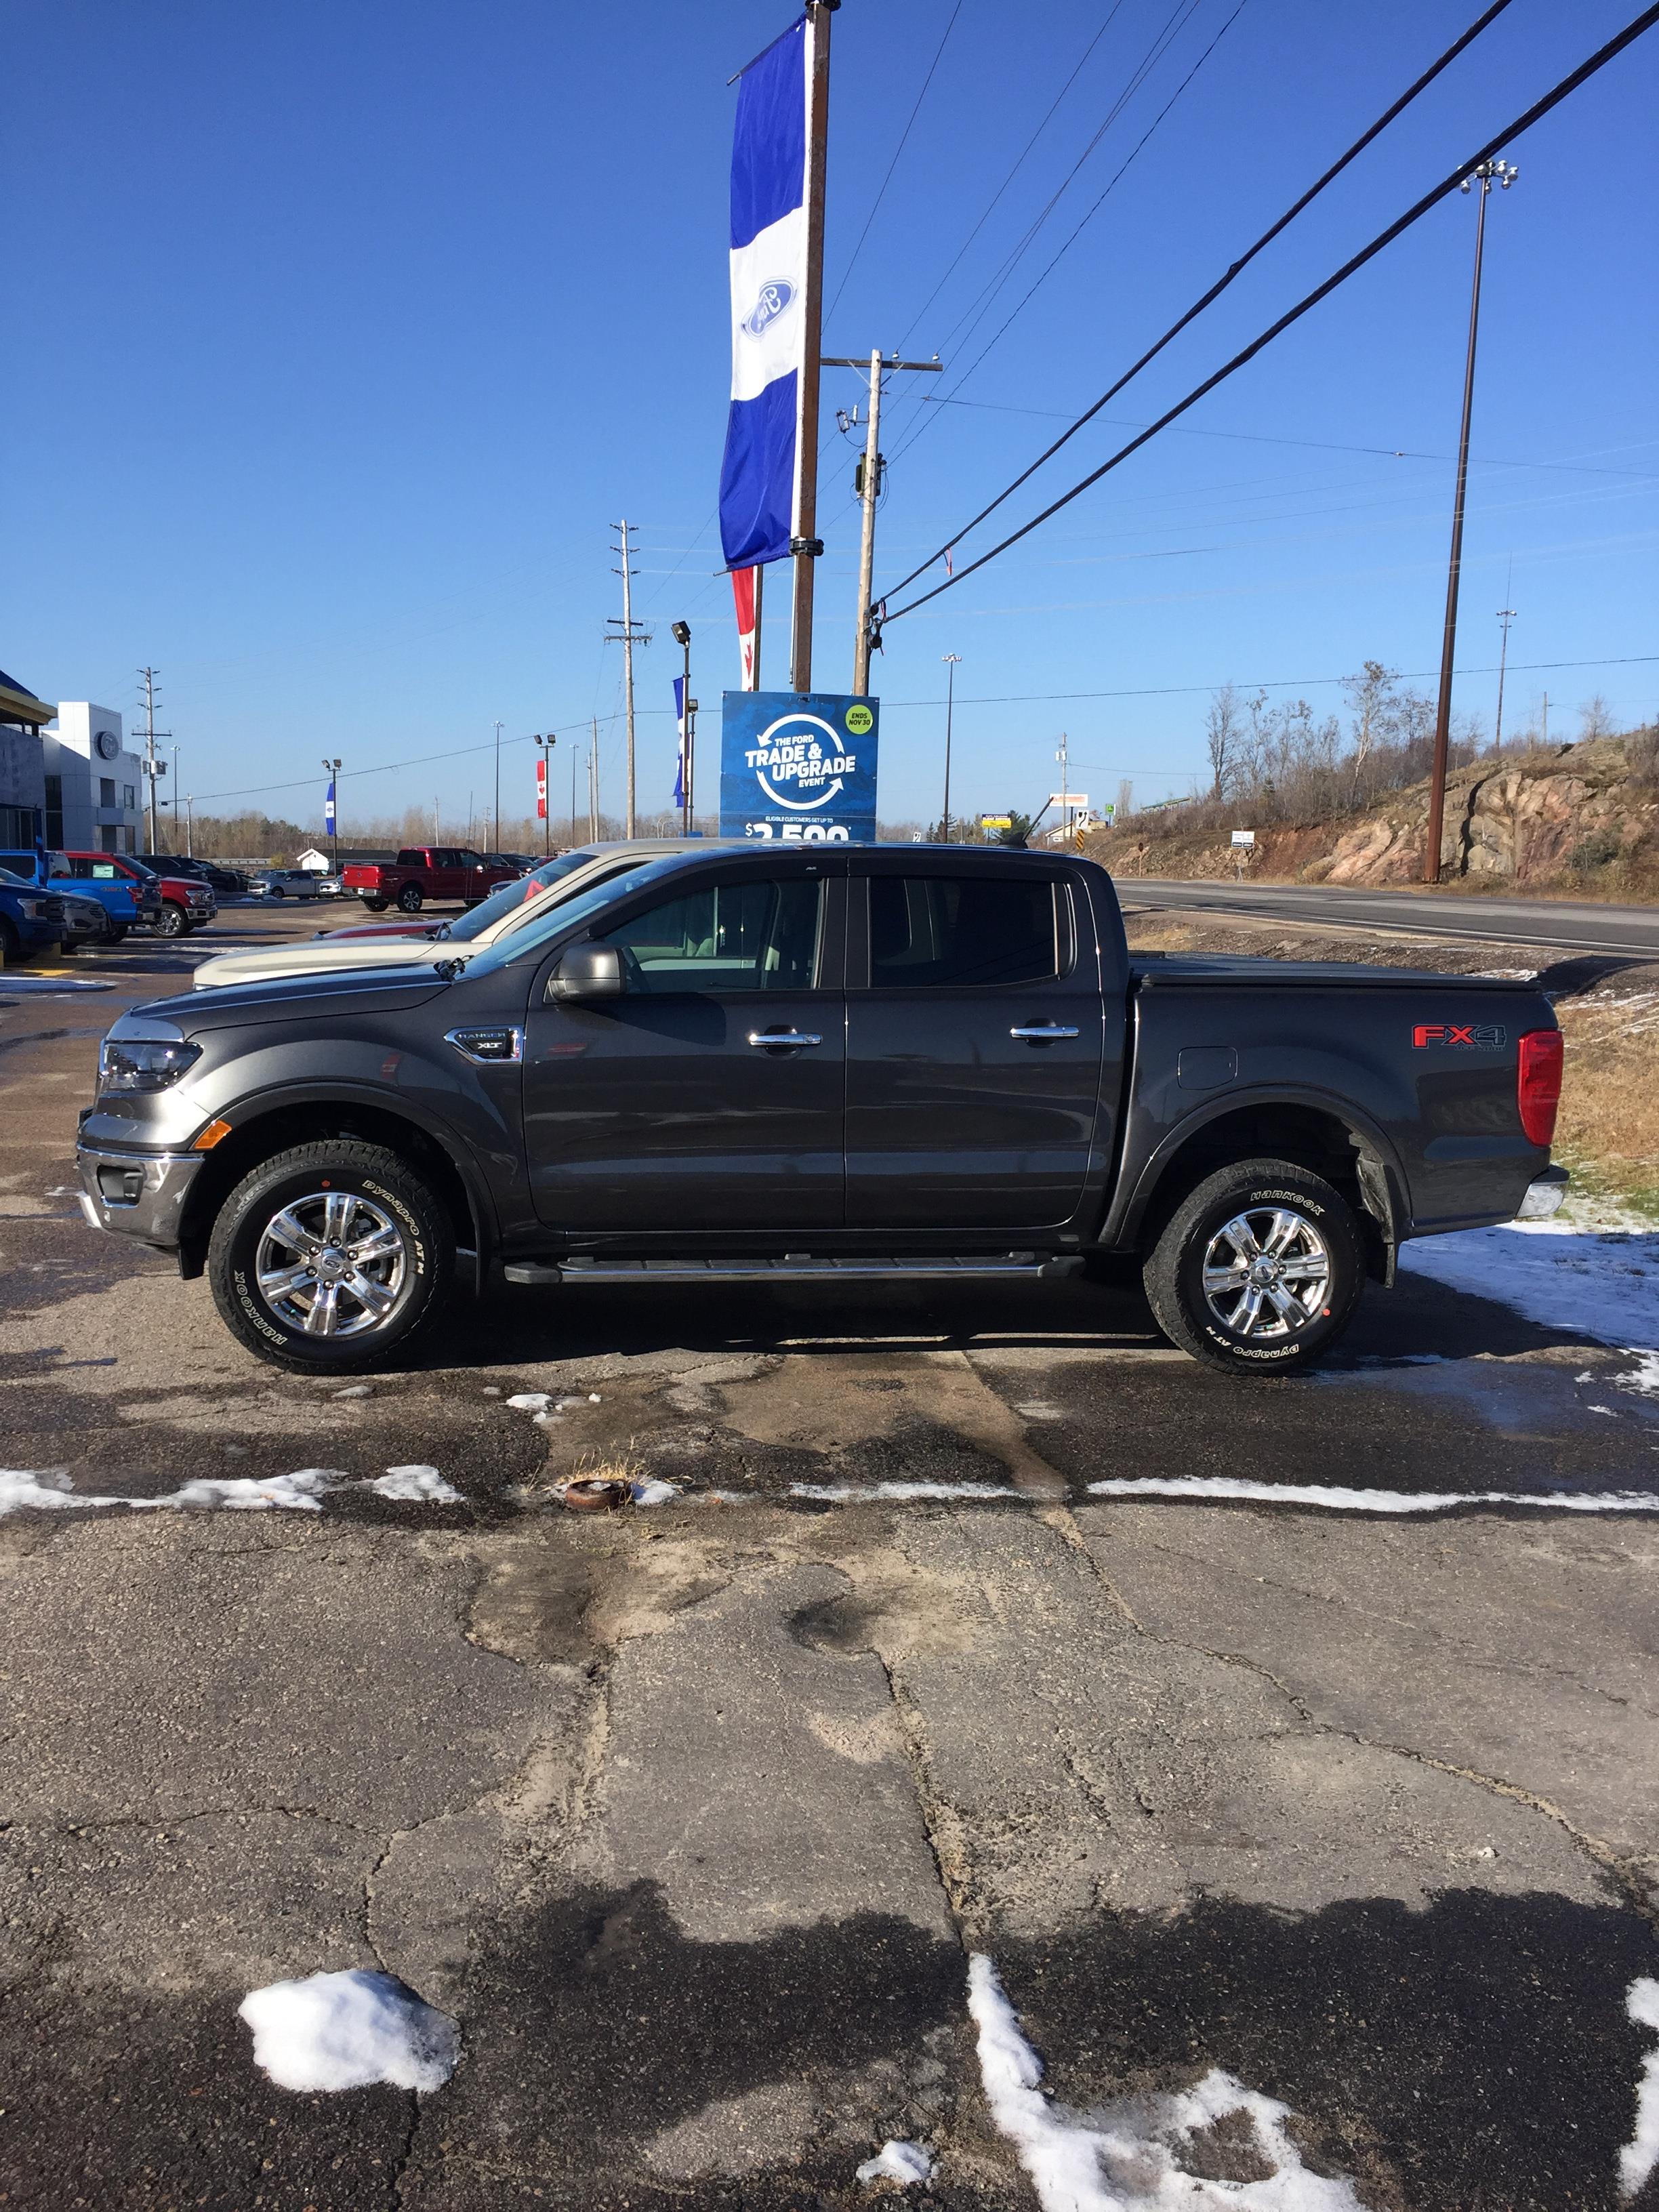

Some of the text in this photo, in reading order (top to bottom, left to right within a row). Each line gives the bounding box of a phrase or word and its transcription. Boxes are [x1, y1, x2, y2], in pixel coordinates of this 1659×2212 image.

[775, 735, 815, 747] THE FORD
[745, 743, 823, 768] TRADE &
[772, 756, 856, 781] UPGRADE
[798, 777, 825, 787] EVENT
[1412, 1024, 1507, 1049] FX4
[362, 1179, 420, 1237] Dynapro
